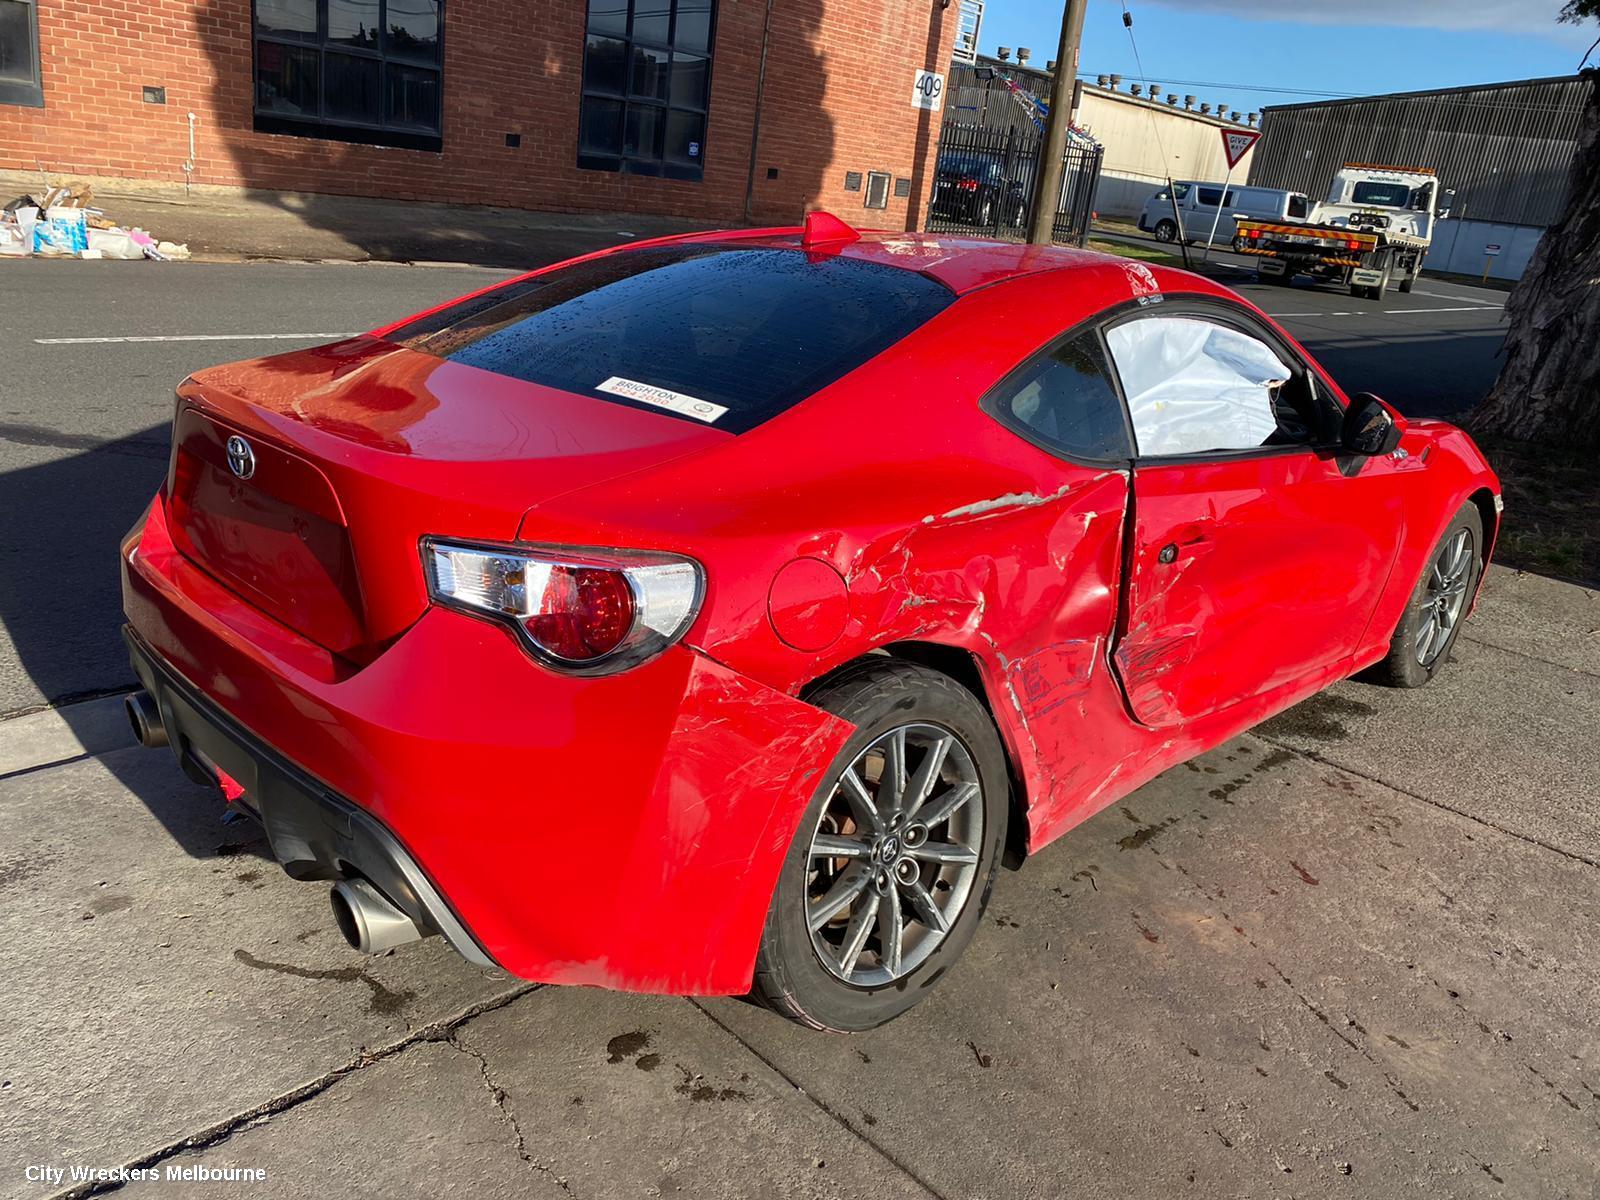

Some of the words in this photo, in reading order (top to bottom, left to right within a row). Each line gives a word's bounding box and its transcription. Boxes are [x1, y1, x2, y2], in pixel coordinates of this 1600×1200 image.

[915, 75, 942, 98] 409
[1230, 136, 1248, 145] GIVE
[616, 380, 677, 401] BRIGHTON
